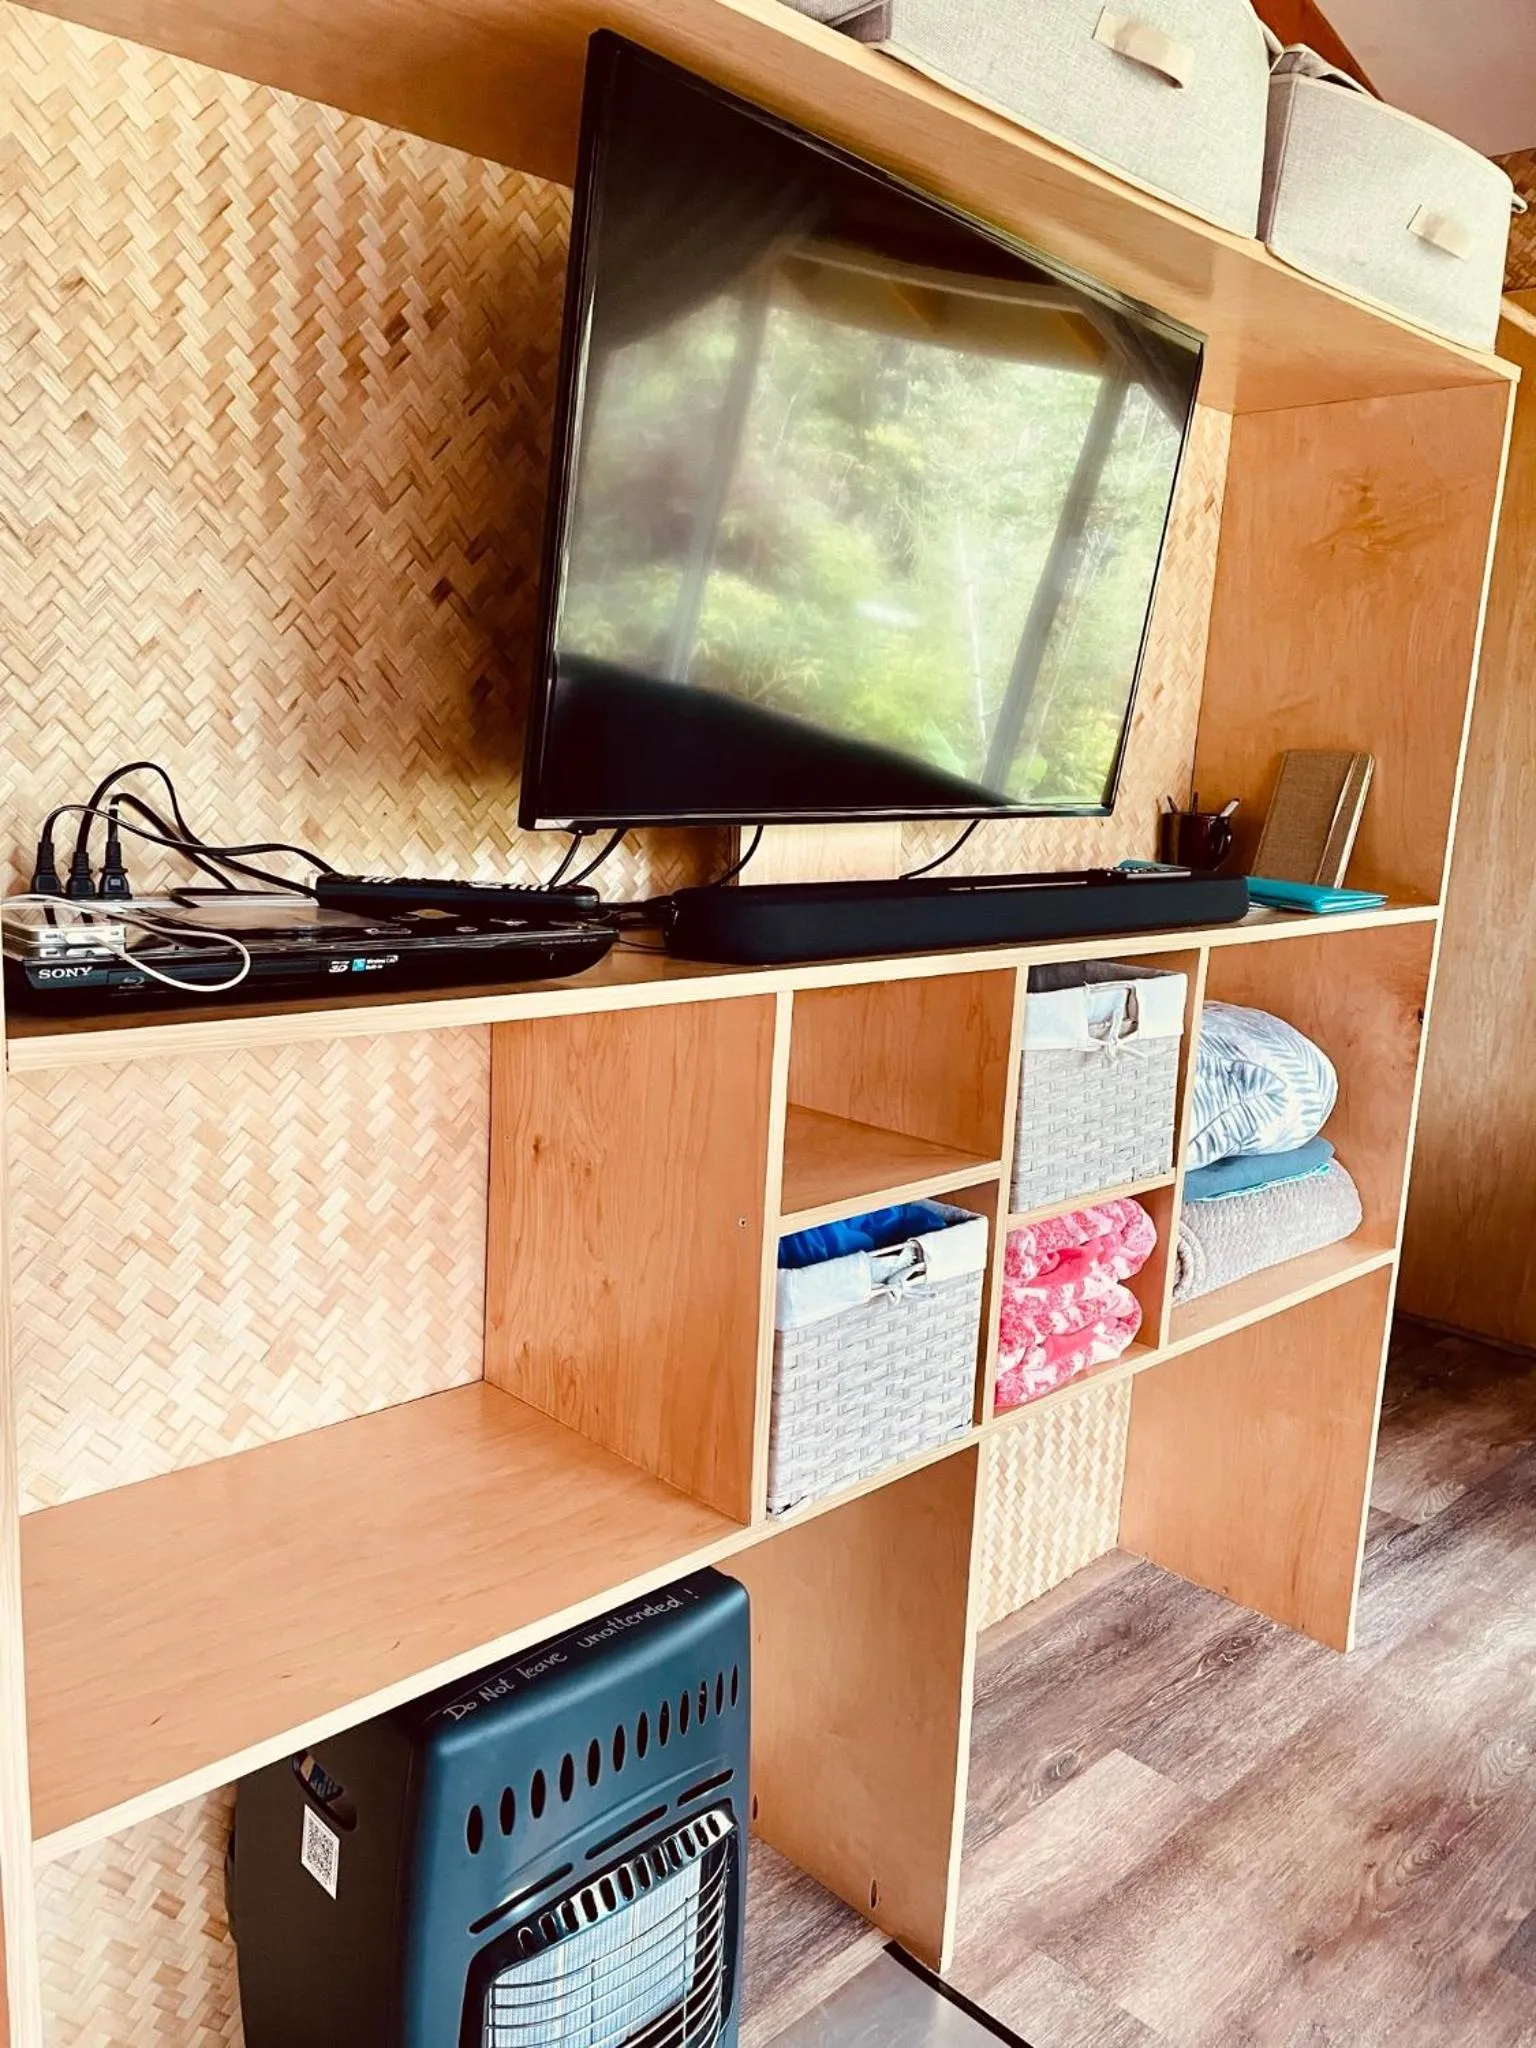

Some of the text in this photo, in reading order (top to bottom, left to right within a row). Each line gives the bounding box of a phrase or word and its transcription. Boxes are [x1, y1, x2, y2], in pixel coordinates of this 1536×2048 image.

[38, 966, 93, 980] SONY
[442, 1701, 478, 1721] Do
[478, 1678, 516, 1702] Not
[515, 1651, 568, 1679] leave
[576, 1594, 684, 1648] unattended
